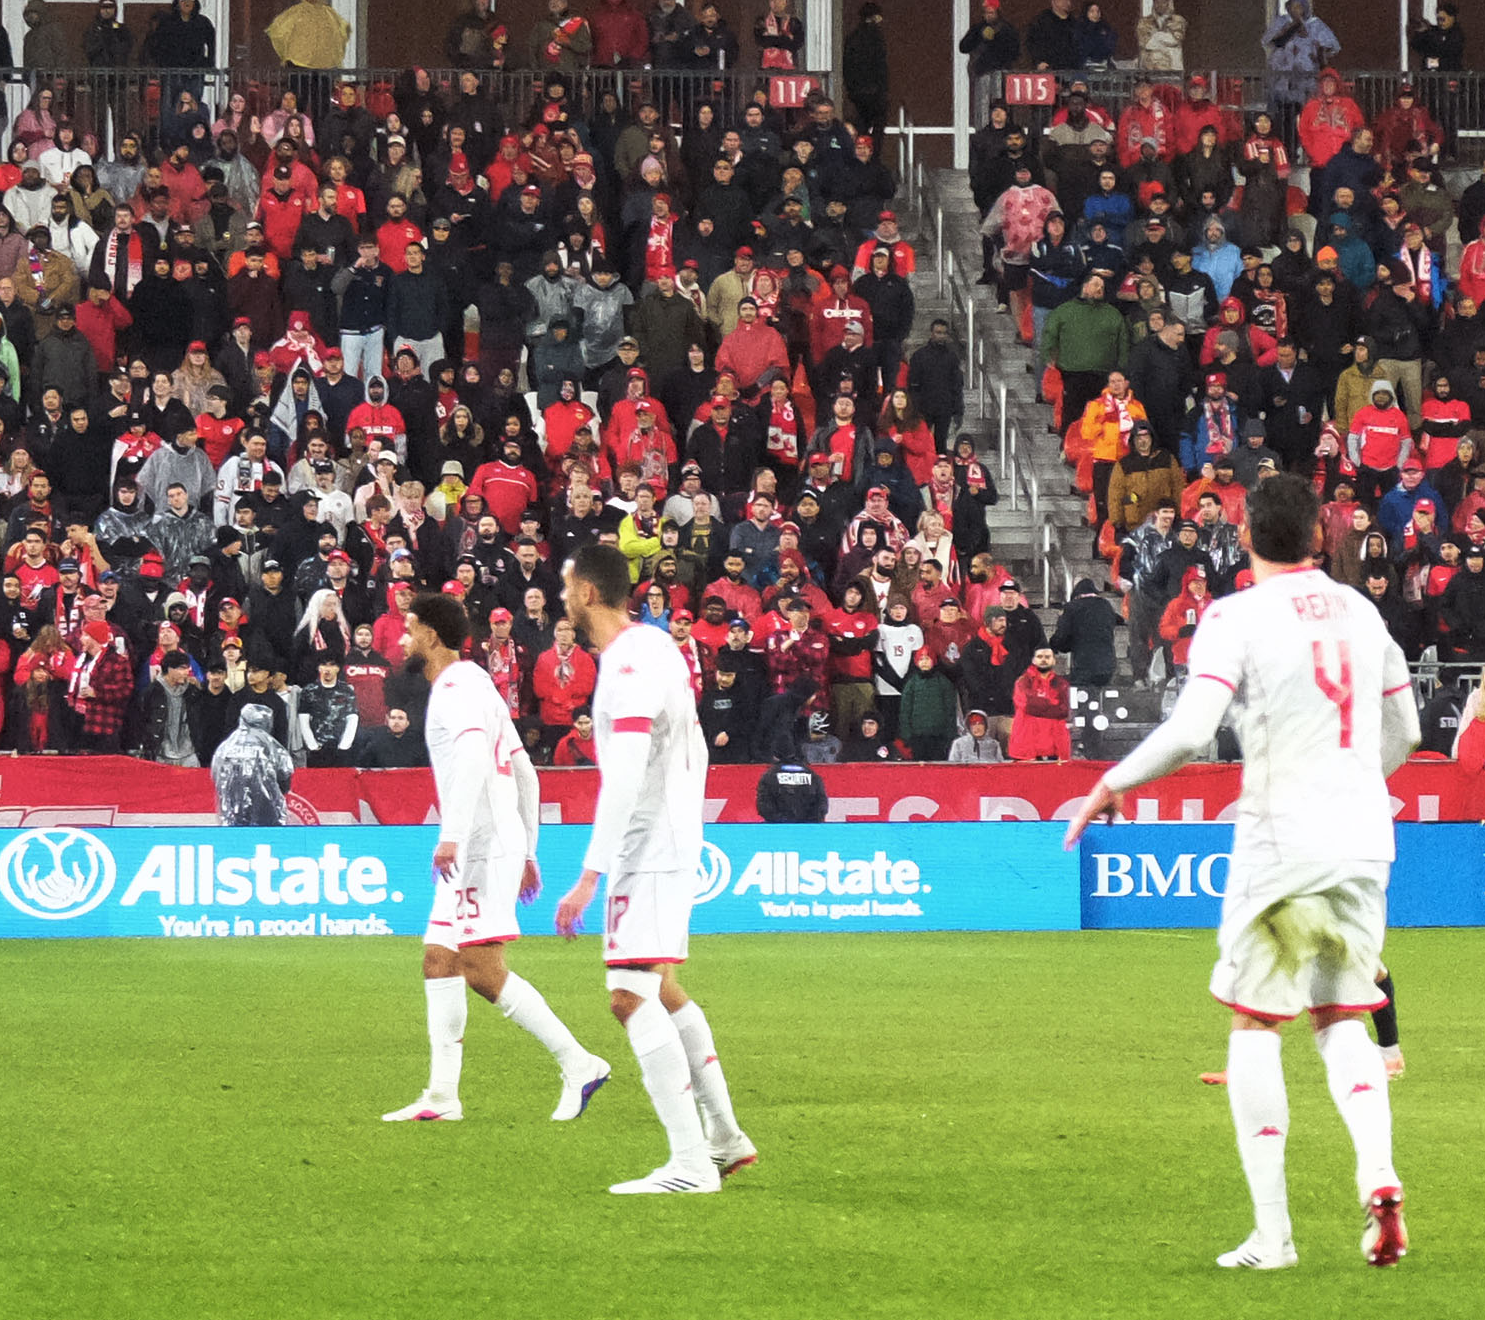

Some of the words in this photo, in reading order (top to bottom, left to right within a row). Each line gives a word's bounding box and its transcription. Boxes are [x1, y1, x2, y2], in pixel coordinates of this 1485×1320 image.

[776, 79, 811, 105] 114
[1012, 77, 1049, 101] 115
[1310, 640, 1352, 749] 4
[158, 915, 230, 937] You're
[233, 916, 255, 936] in
[259, 913, 316, 936] good
